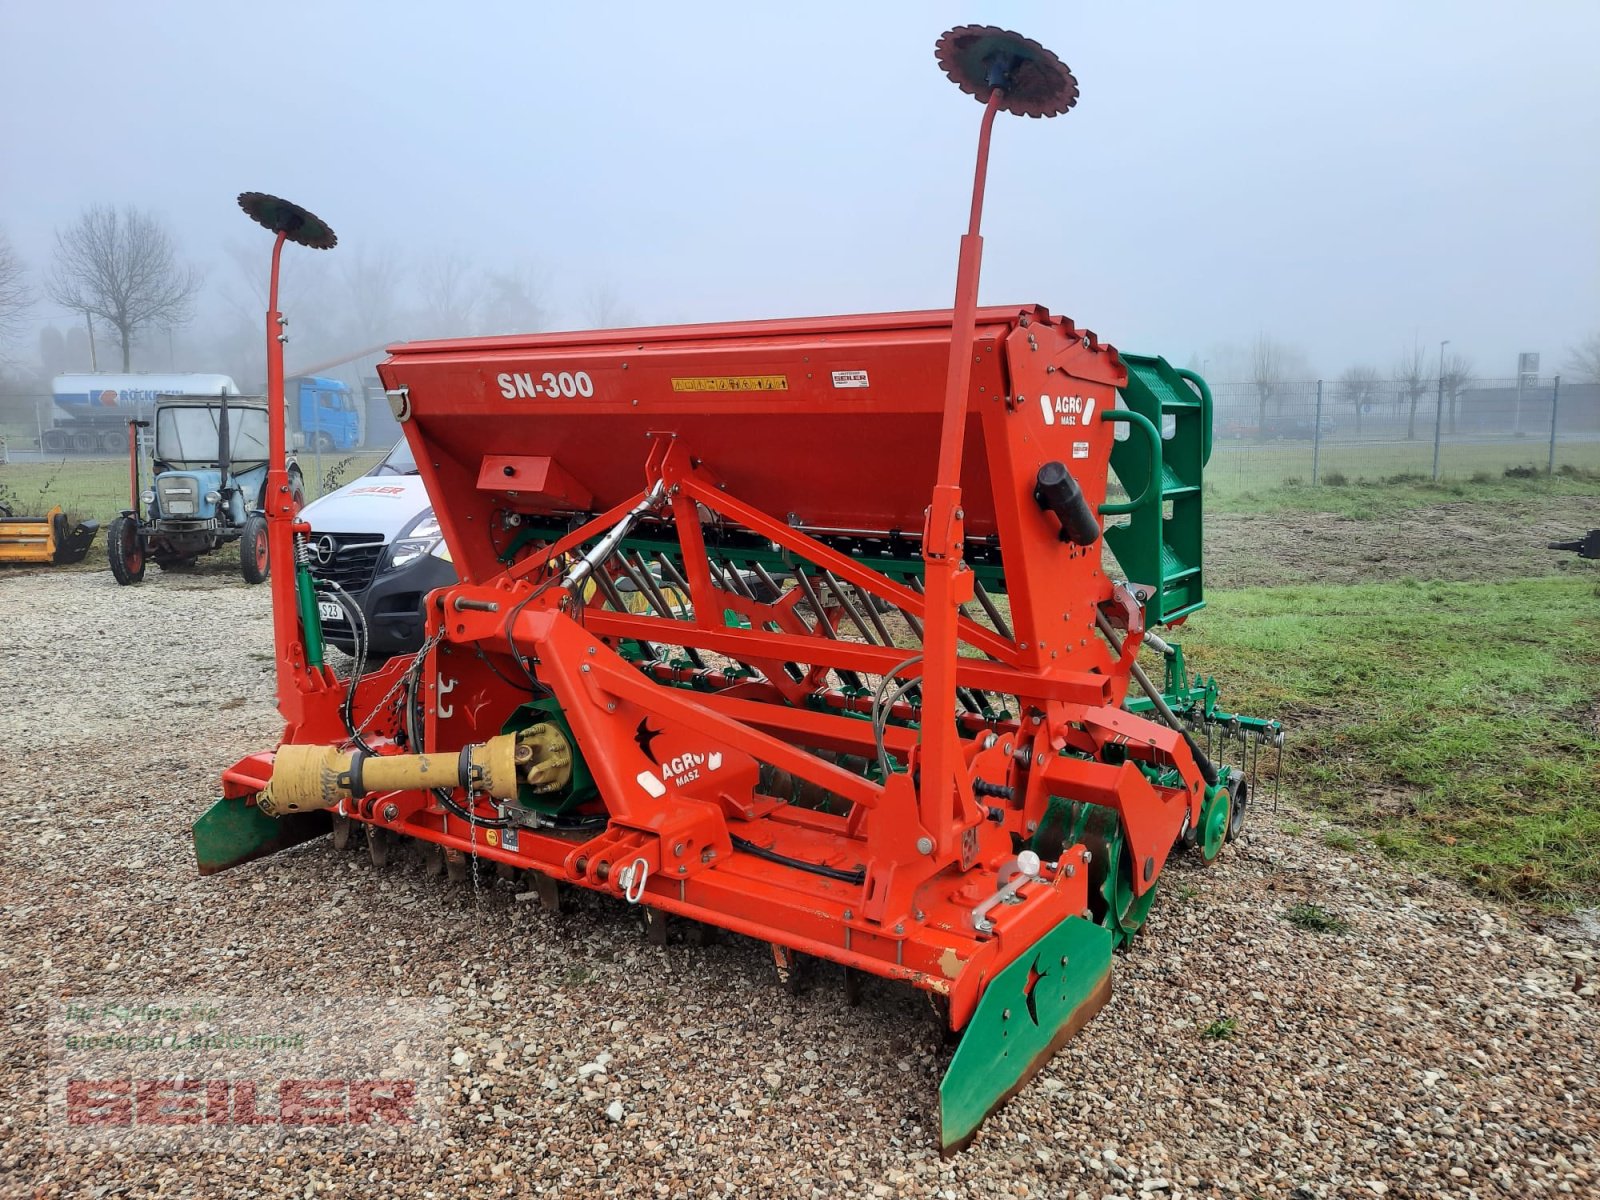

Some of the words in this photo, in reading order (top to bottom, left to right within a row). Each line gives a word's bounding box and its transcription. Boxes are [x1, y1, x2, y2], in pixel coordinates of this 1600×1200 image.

[497, 371, 594, 399] SN-300
[1055, 396, 1082, 414] AGRO
[1060, 415, 1076, 426] MASZ
[675, 769, 700, 788] MASZ
